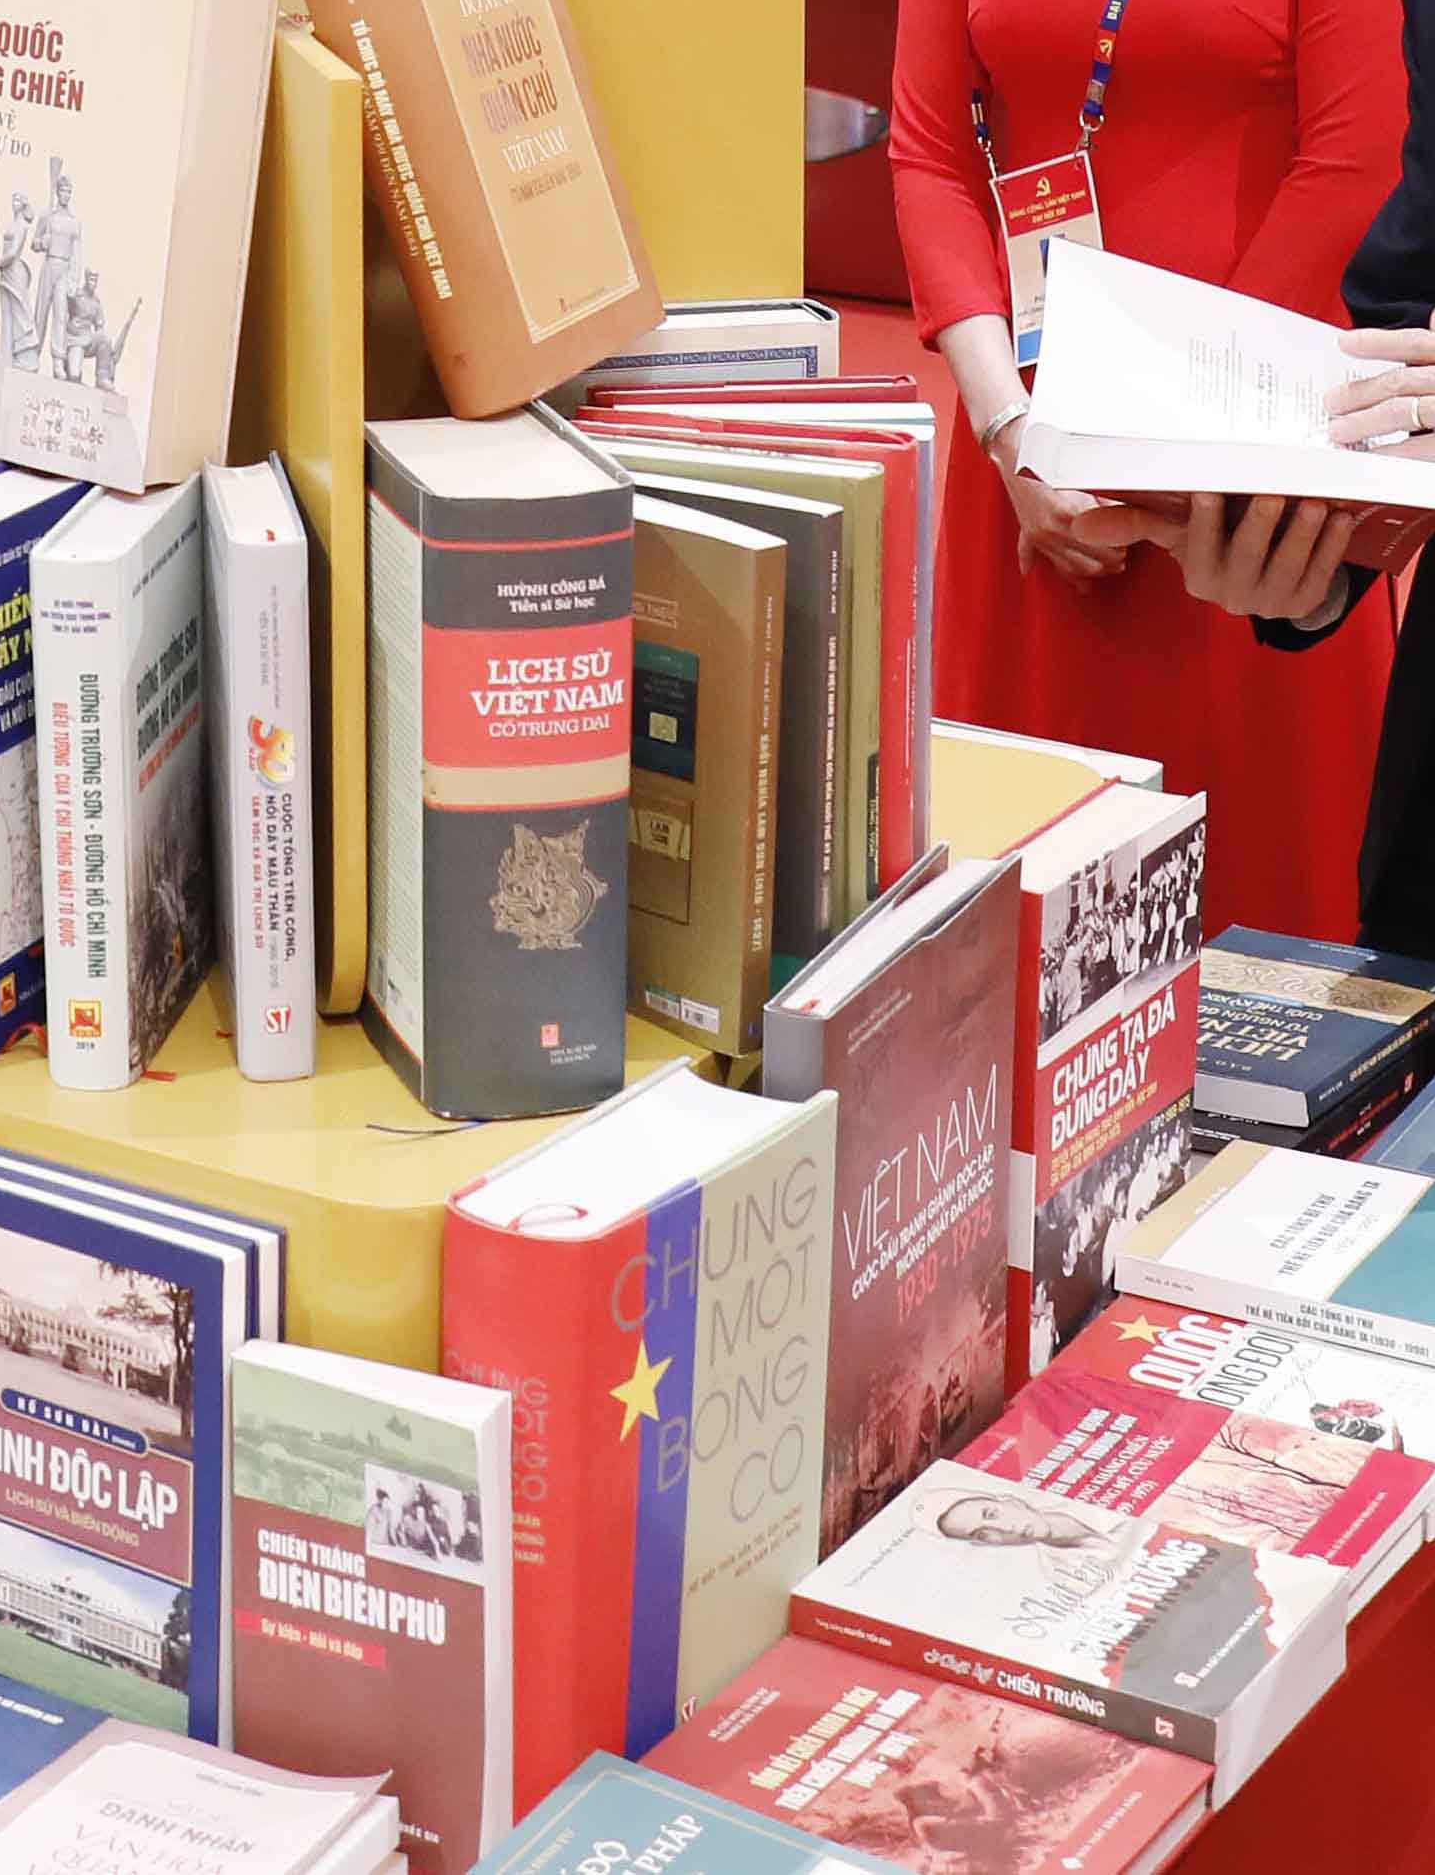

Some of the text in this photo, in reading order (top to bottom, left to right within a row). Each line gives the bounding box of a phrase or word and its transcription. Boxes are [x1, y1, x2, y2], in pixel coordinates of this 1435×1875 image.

[10, 69, 84, 112] CHIẾN
[11, 139, 31, 157] DO
[497, 574, 606, 597] HUỲNH CÔNG BÁ
[487, 646, 612, 686] LỊCH SỬ
[470, 679, 625, 718] VIỆT NAM
[489, 714, 610, 738] CỔ TRUNG ĐẠI
[88, 939, 109, 980] MINH
[1053, 984, 1176, 1107] CHÚNG TA ĐÃ
[1109, 1046, 1151, 1108] DẬY
[843, 1063, 997, 1270] VIỆT NAM
[611, 1156, 818, 1332] CHUNG
[49, 1447, 112, 1509] ĐỘC
[118, 1469, 178, 1531] LẬP
[257, 1527, 366, 1579] CHIẾN THẮNG
[258, 1556, 446, 1646] ĐIỆN BIÊN PHỦ
[996, 1668, 1107, 1718] CHIẾN TRƯỜNG
